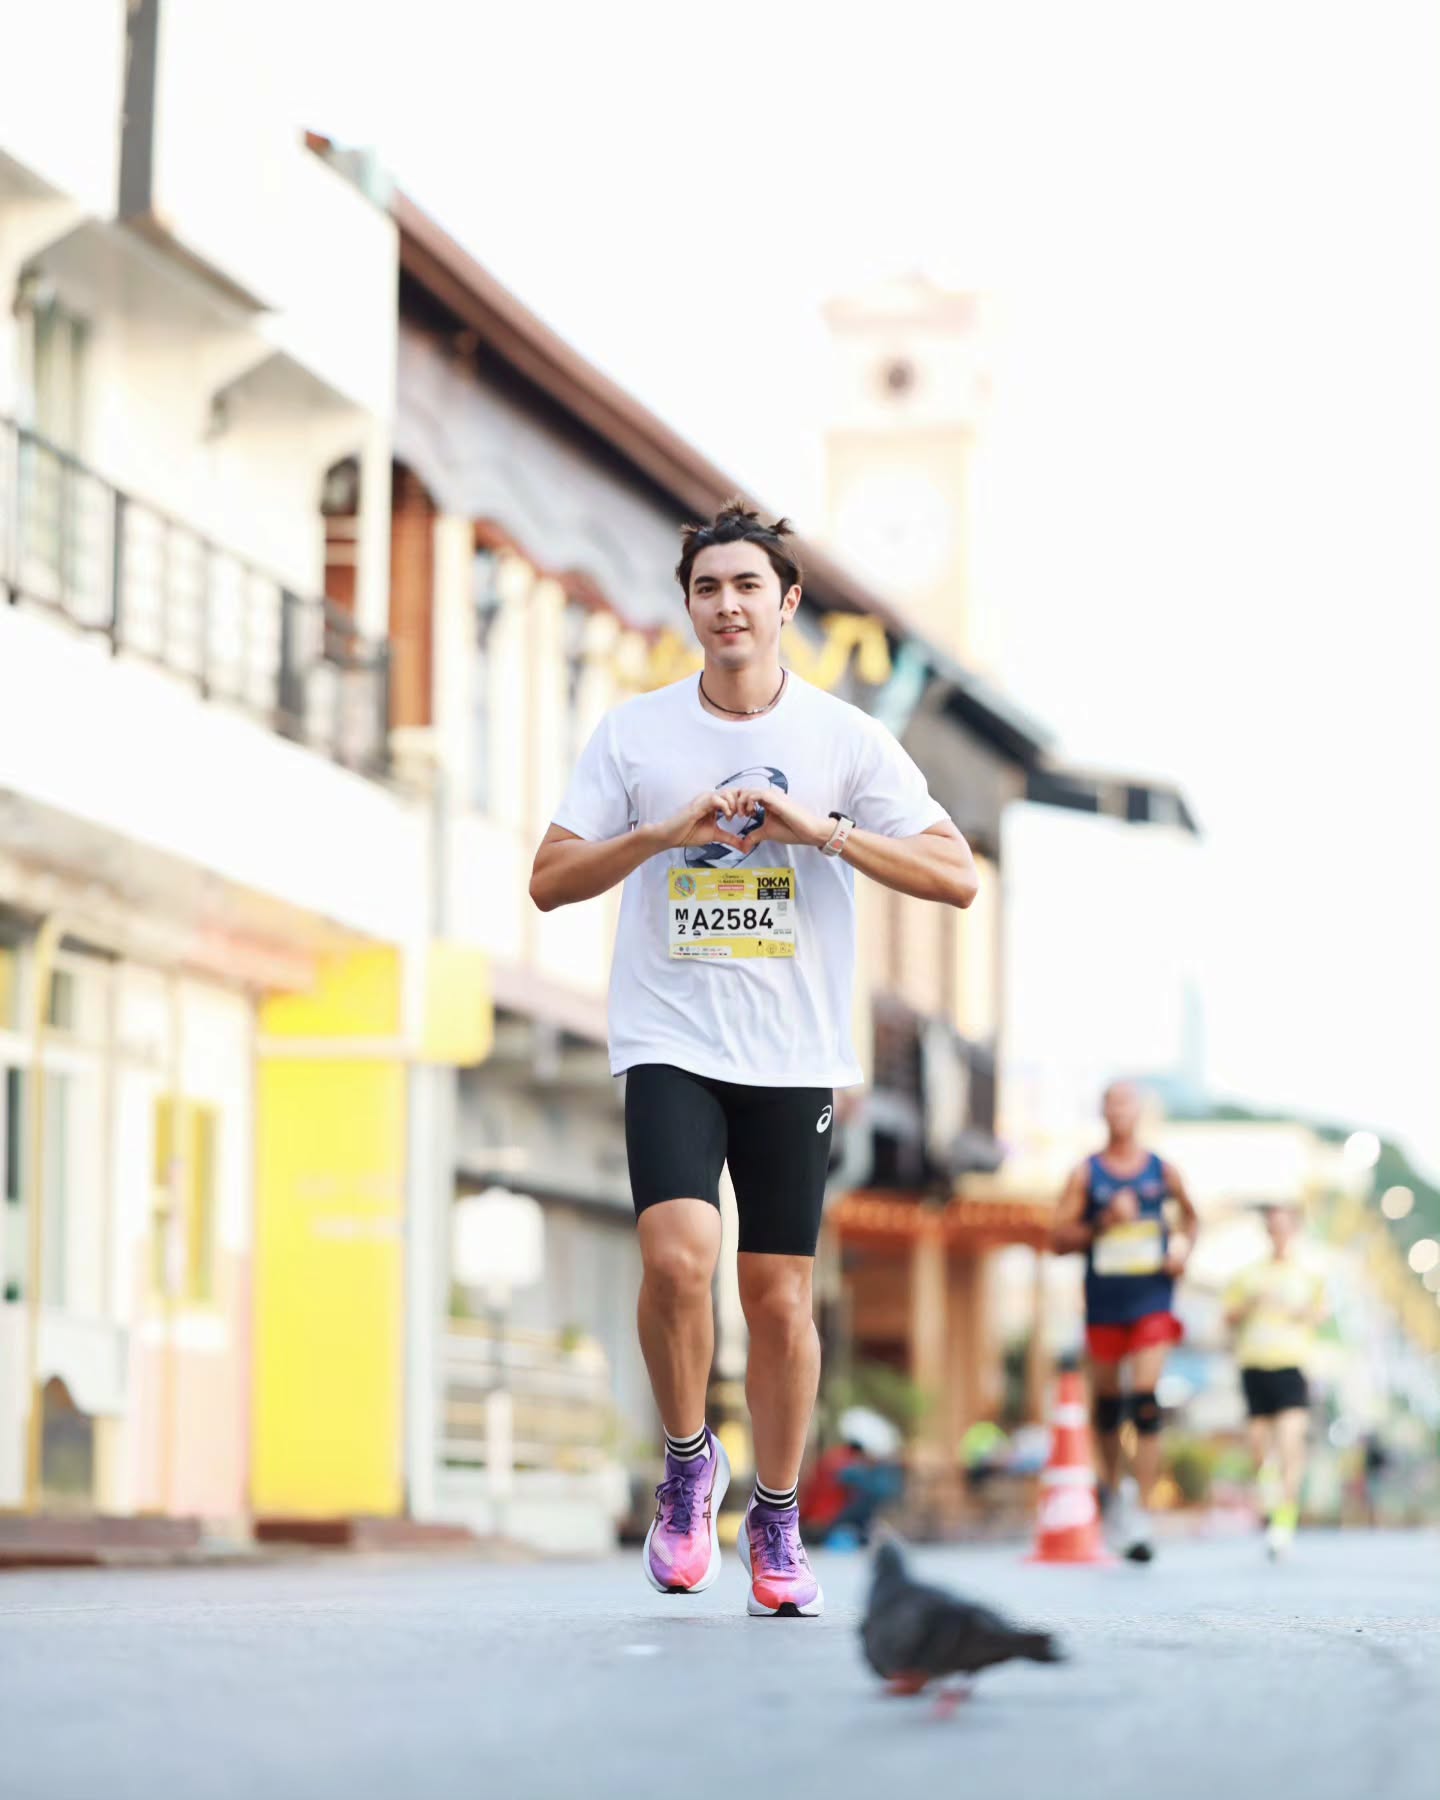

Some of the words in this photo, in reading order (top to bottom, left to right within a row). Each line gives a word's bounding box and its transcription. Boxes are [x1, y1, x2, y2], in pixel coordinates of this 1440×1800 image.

[757, 877, 790, 888] 10KM
[675, 908, 689, 921] M
[691, 907, 774, 931] A2584
[678, 924, 686, 935] 2
